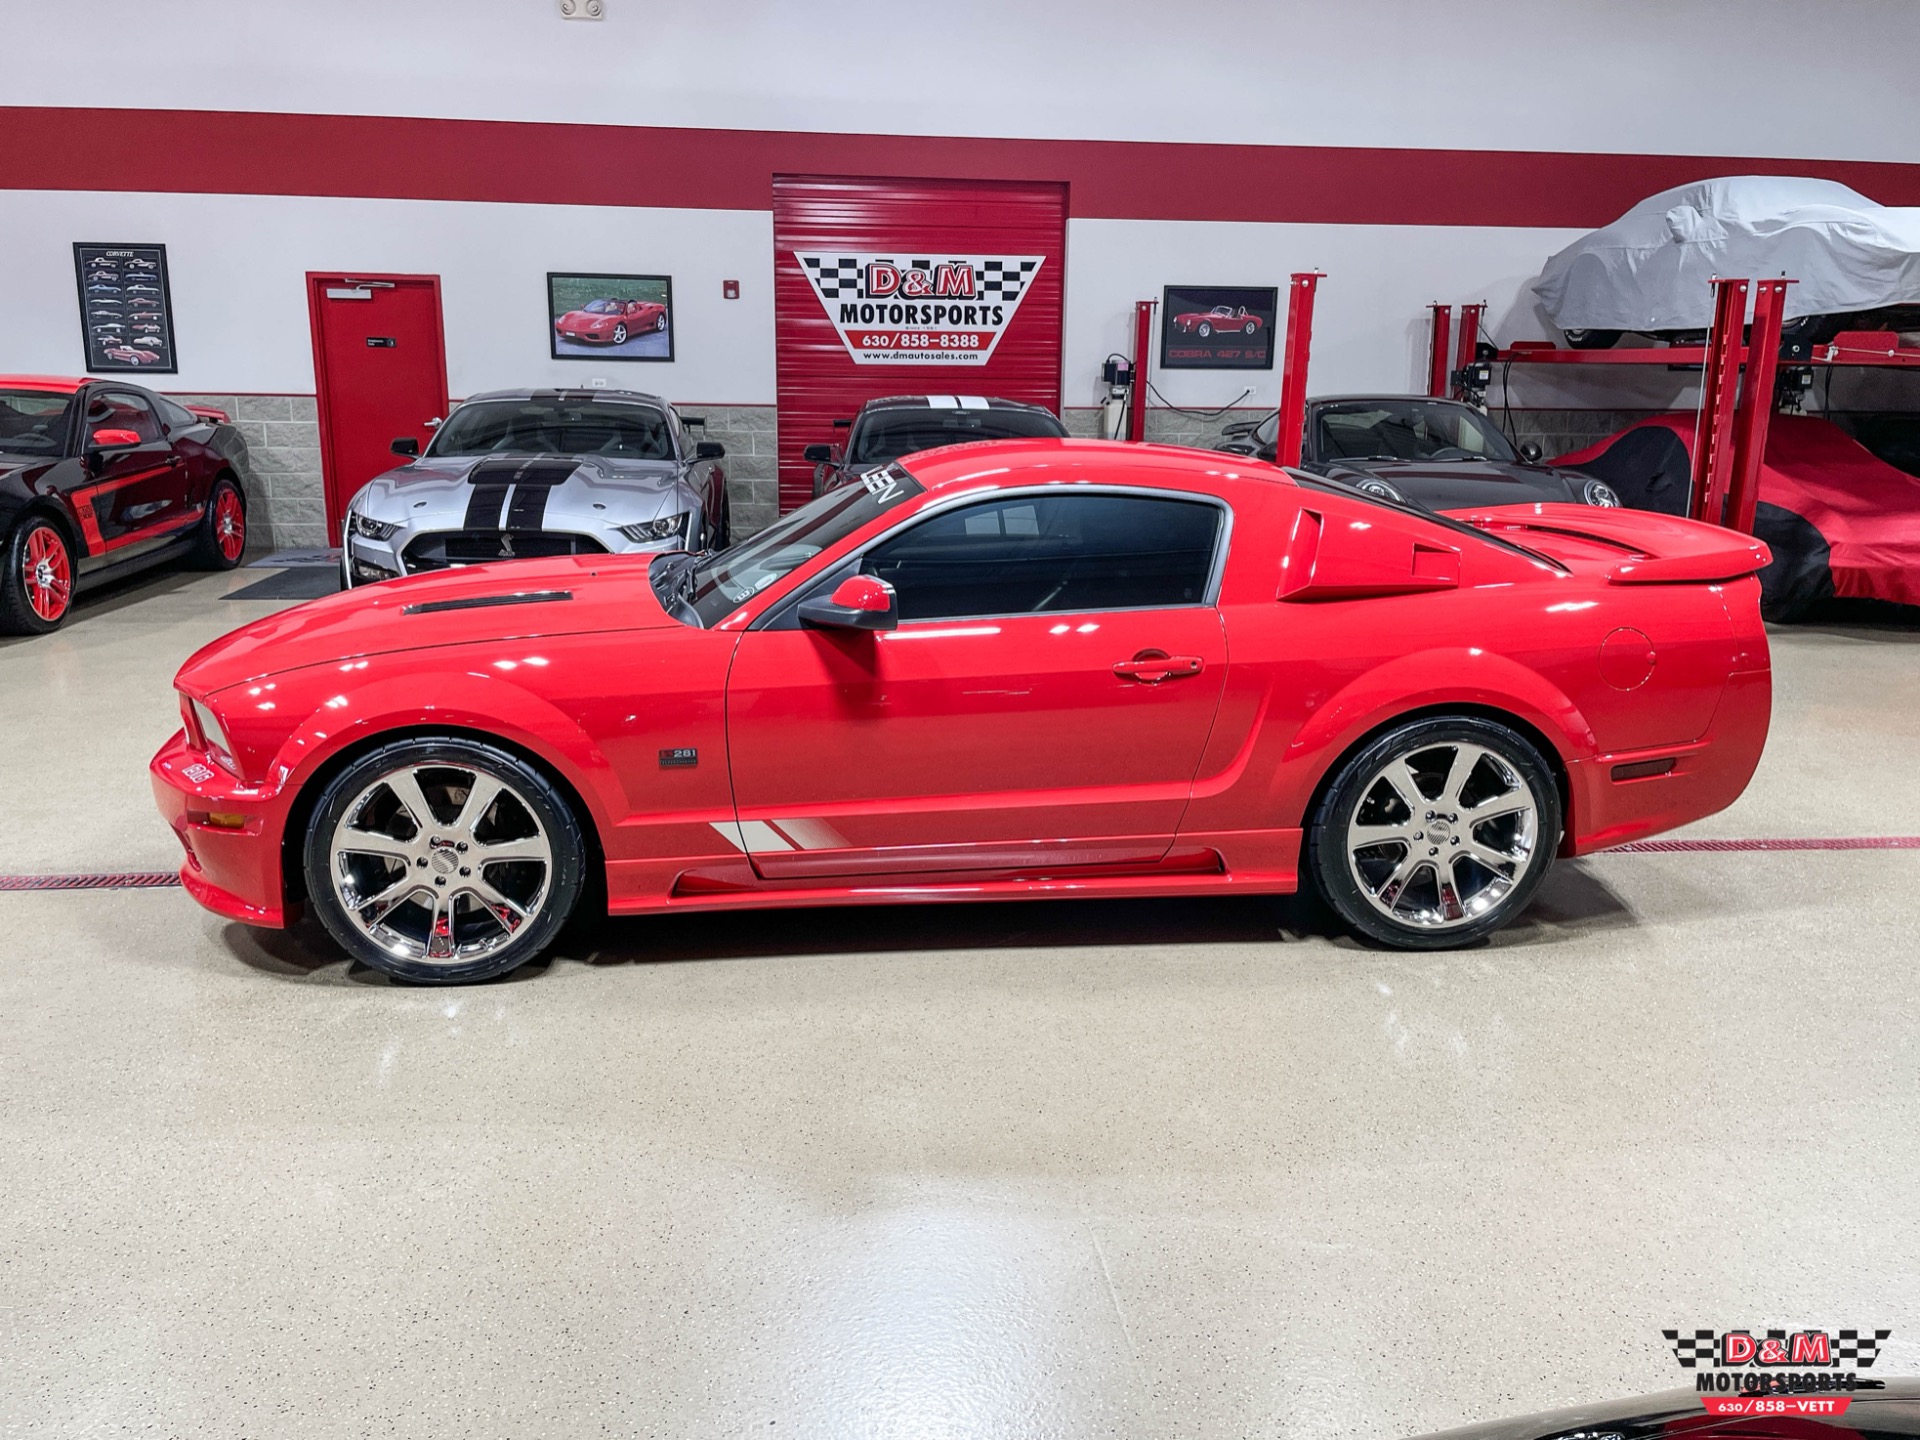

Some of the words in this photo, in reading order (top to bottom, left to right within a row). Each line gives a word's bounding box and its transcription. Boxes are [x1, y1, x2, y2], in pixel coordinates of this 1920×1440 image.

[866, 262, 977, 300] D&M
[840, 304, 1003, 325] MOTORSPORTS
[862, 333, 979, 348] 630/858-8388
[863, 351, 979, 361] www.dmautosales.com
[1168, 350, 1212, 358] COBRA
[1217, 350, 1241, 358] 427
[674, 749, 696, 757] 281
